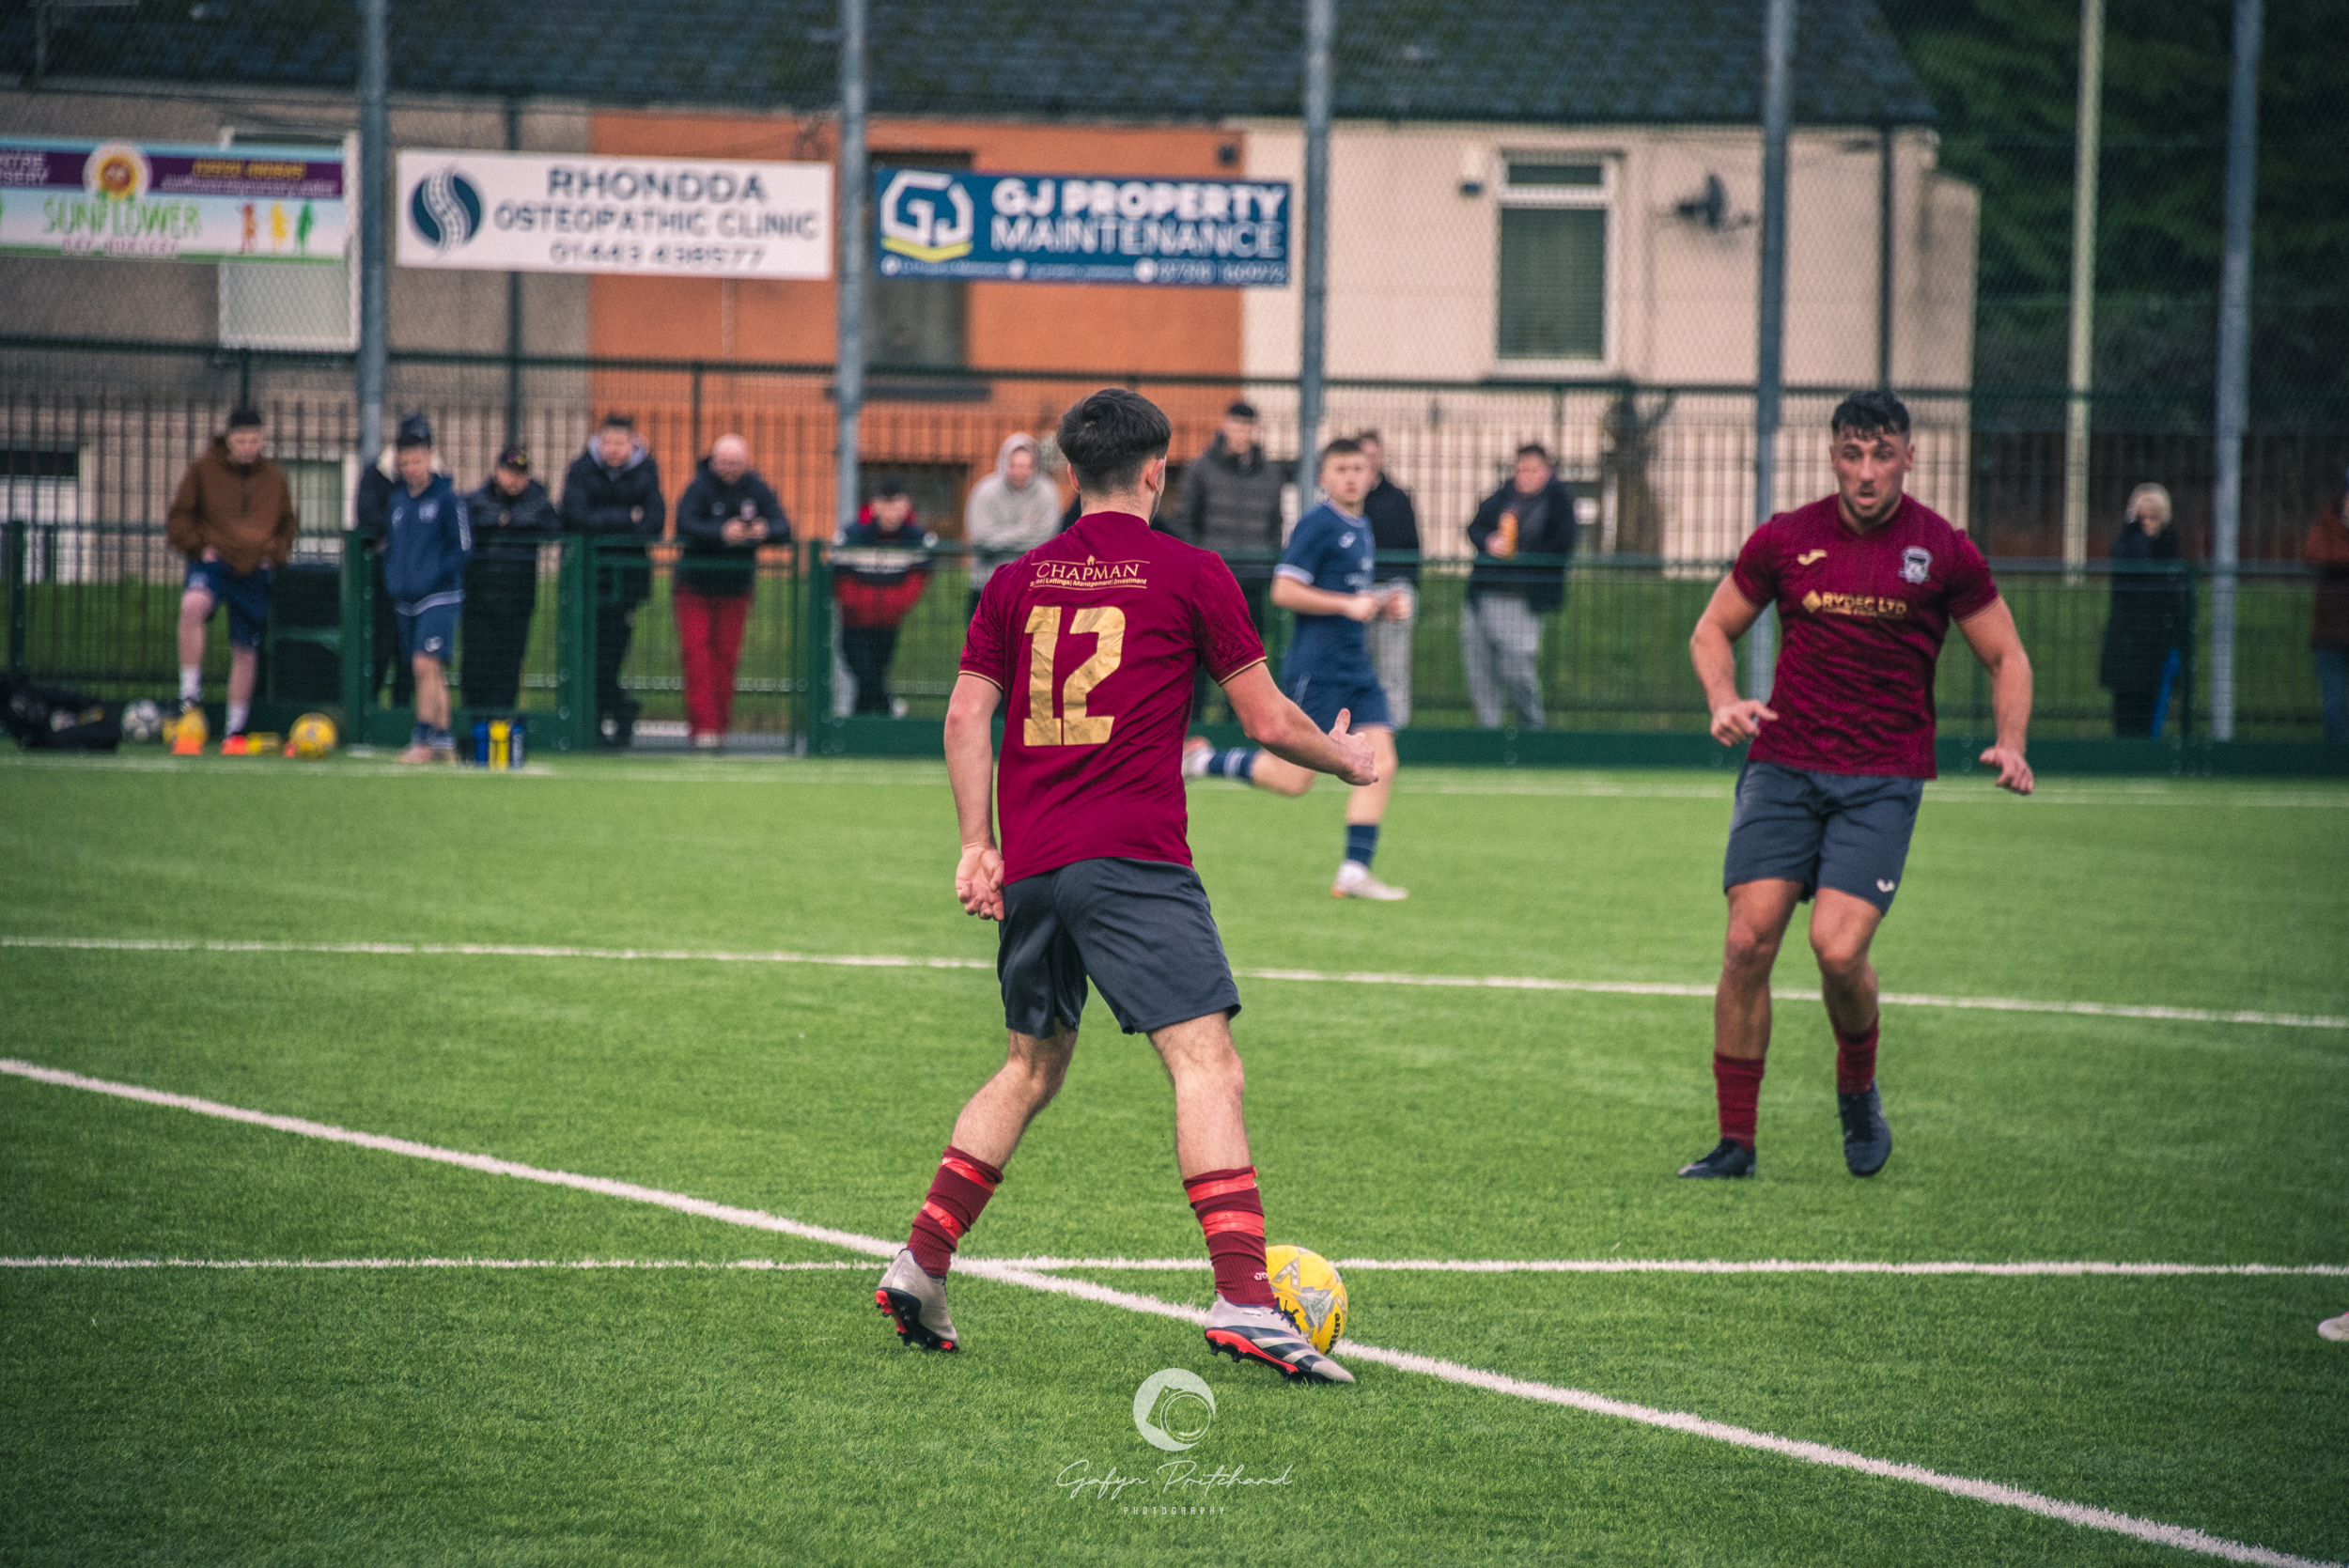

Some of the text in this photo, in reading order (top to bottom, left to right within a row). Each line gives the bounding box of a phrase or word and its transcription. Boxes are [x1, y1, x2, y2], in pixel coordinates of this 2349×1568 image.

[547, 166, 768, 204] RHONDDA
[991, 177, 1287, 222] GJ PROPERTY
[43, 197, 202, 238] SUNFLOWER
[493, 198, 822, 240] OSTEOPATHIC CLINIC
[989, 215, 1285, 258] MAINTENANCE
[549, 239, 643, 265] 01443
[1035, 563, 1140, 582] CHAPMAN
[1045, 577, 1070, 586] Lettings
[1072, 579, 1112, 588] Management
[1113, 577, 1147, 585] Investment
[1023, 605, 1126, 747] 12
